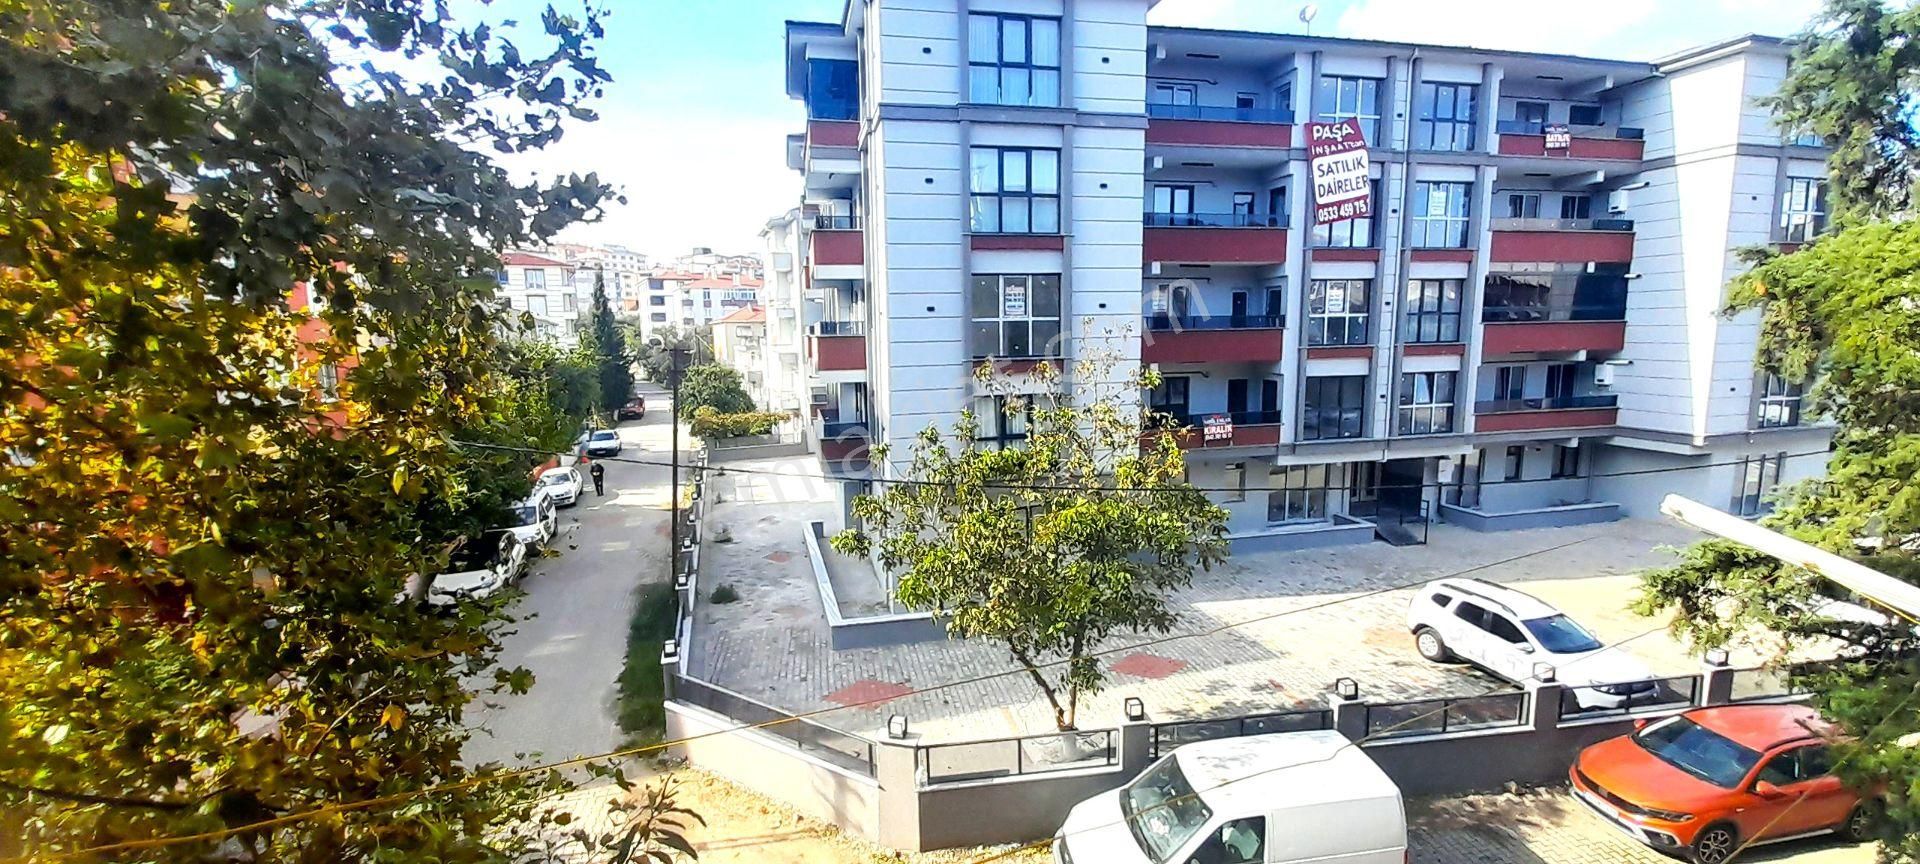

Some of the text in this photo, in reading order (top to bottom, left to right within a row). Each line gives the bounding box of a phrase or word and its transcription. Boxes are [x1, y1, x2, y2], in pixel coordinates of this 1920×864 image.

[1312, 123, 1355, 141] PAŞA
[1317, 155, 1366, 178] SATILIK
[1318, 175, 1370, 198] DAİRELER
[1318, 205, 1338, 222] 0533
[1339, 202, 1354, 217] 459
[1354, 200, 1367, 214] 75
[1204, 424, 1233, 435] KIRALIK
